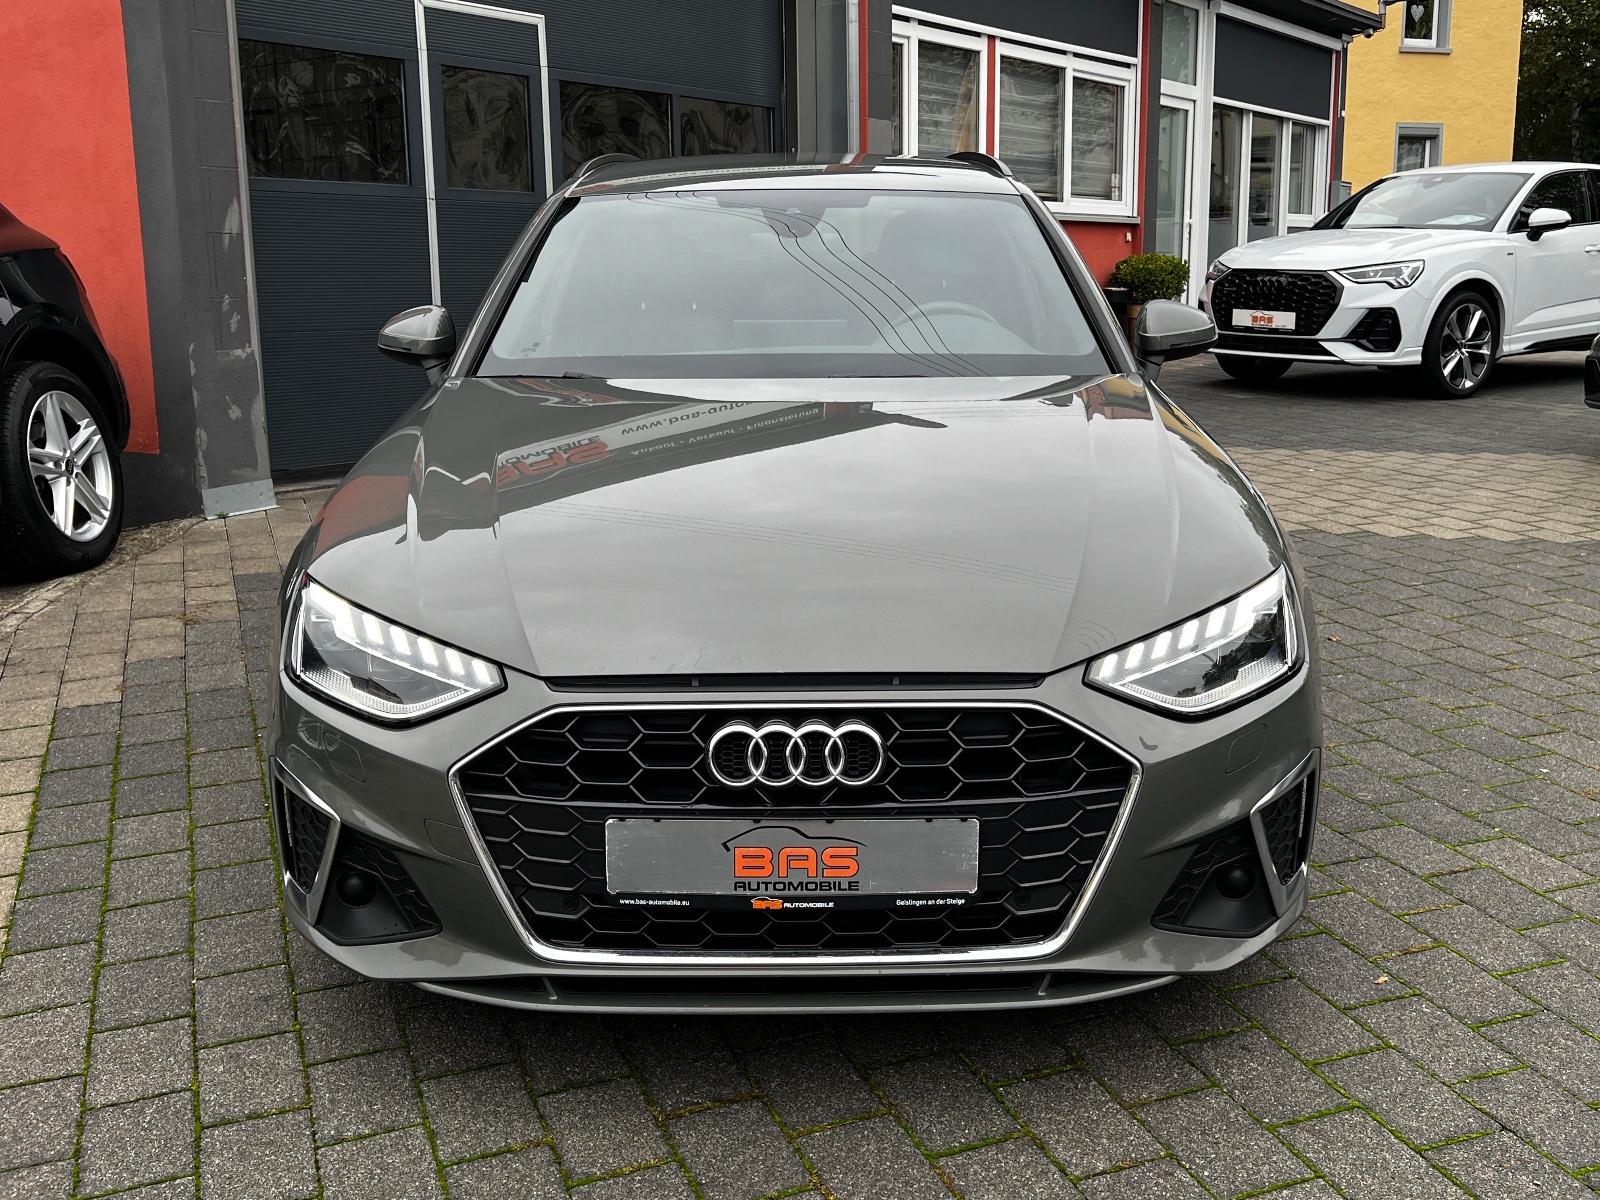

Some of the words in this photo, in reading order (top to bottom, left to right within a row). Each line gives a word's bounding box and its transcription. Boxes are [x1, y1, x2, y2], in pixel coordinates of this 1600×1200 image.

[733, 846, 860, 879] BAS
[733, 880, 860, 892] AUTOMOBILE
[752, 900, 783, 910] BAS
